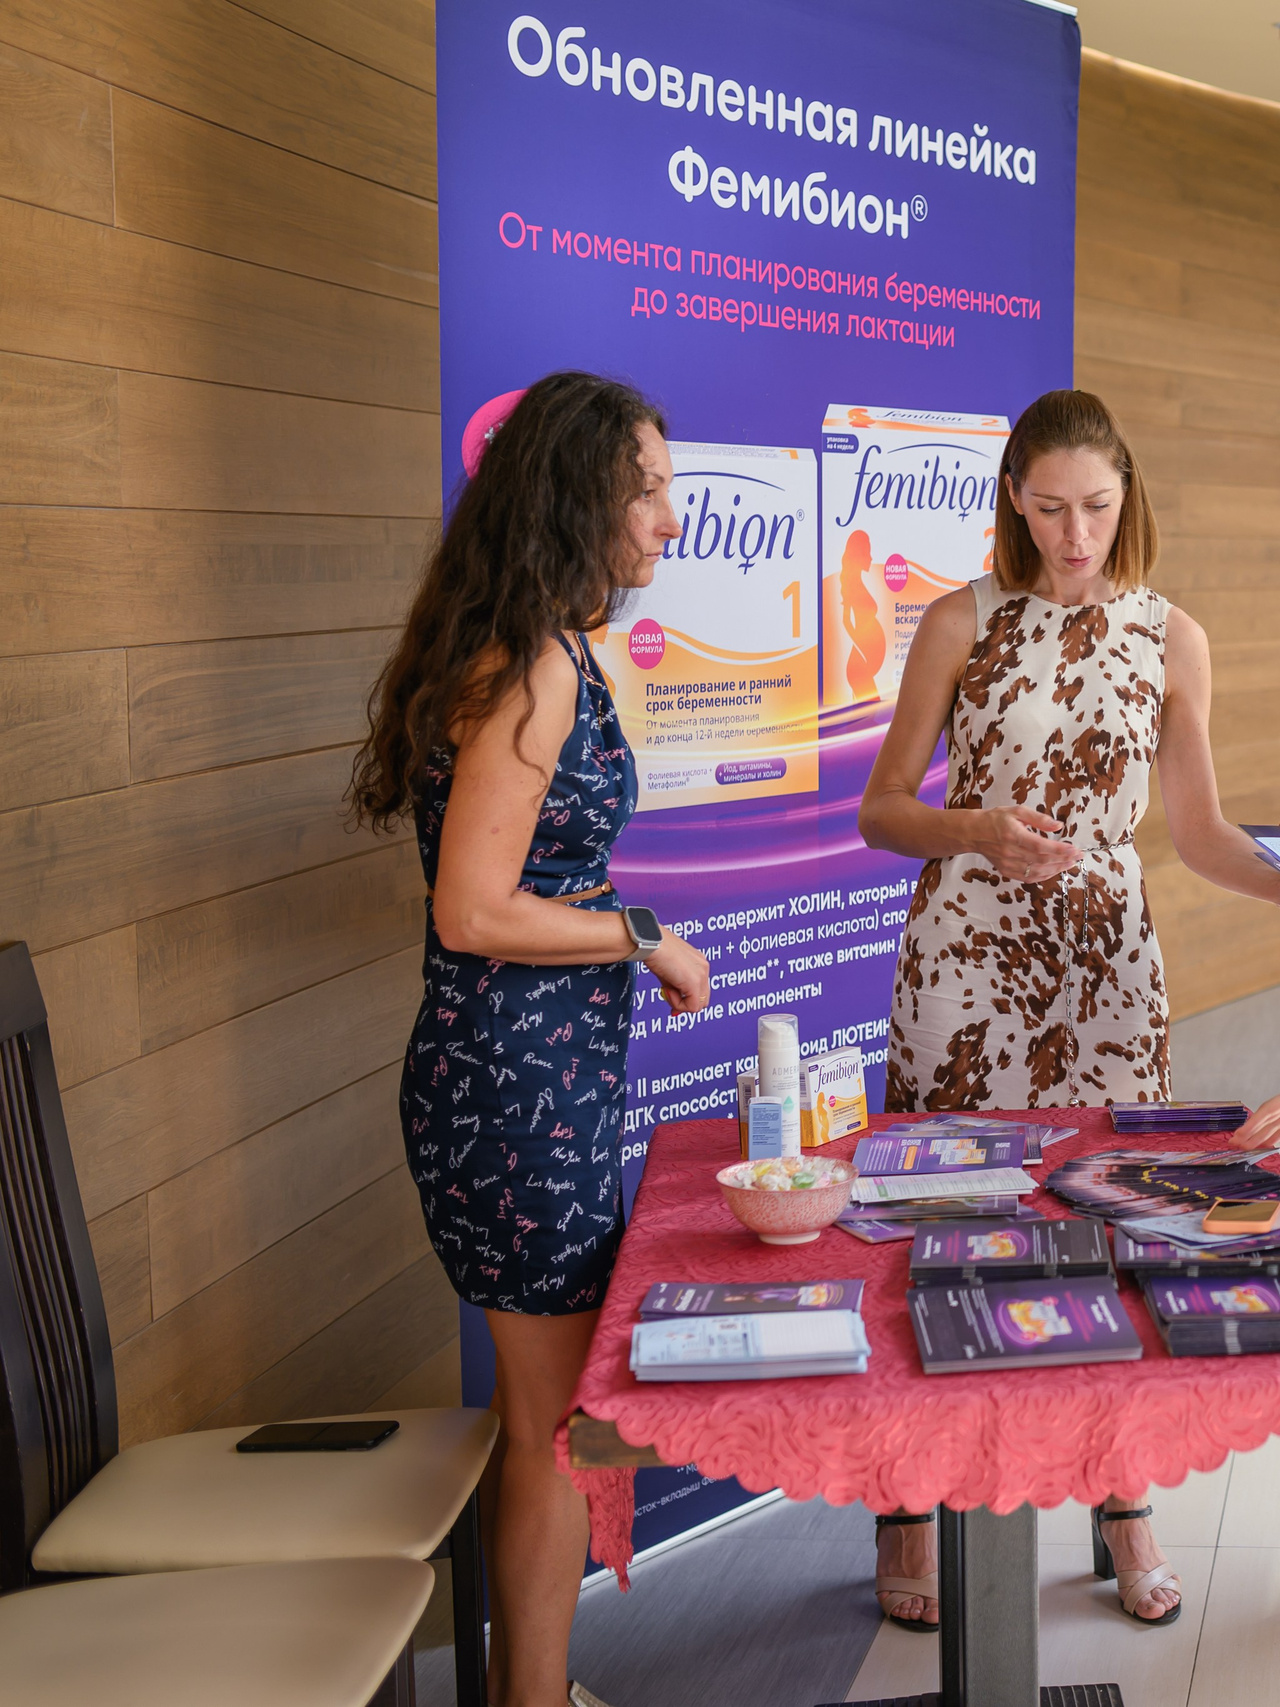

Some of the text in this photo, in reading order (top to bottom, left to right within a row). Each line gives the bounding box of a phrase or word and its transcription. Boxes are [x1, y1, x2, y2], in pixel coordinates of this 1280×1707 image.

[507, 14, 1037, 186] Обновленная линейка
[668, 145, 928, 240] Фемибион®
[498, 211, 1041, 321] От момента планирования беременности
[631, 286, 955, 350] до завершения лактации
[836, 445, 997, 527] femibion
[885, 565, 907, 573] НОВАЯ
[782, 581, 801, 638] 1
[630, 643, 664, 655] ФОРМУЛА
[631, 633, 662, 646] НОВАЯ
[646, 675, 792, 698] Планирование и ранний
[646, 694, 762, 715] срок беременности
[646, 713, 760, 730] От момента планирования
[646, 736, 652, 744] и
[654, 735, 665, 746] до
[667, 732, 693, 744] конца
[696, 729, 713, 740] 12-й
[714, 729, 745, 739] недели
[707, 904, 785, 931] содержит
[789, 889, 845, 917] ХОЛИН,
[849, 878, 907, 906] который
[739, 926, 814, 959] фолиевая
[817, 908, 879, 939] кислота)
[788, 951, 833, 974] также
[837, 939, 895, 964] витамин
[651, 1018, 662, 1033] и
[665, 1004, 724, 1033] другие
[728, 982, 822, 1016] компоненты
[652, 1061, 731, 1095] включает
[814, 1061, 860, 1093] femibion
[856, 1077, 862, 1092] 1
[659, 1087, 738, 1121] способст
[544, 1177, 577, 1195] Angeles
